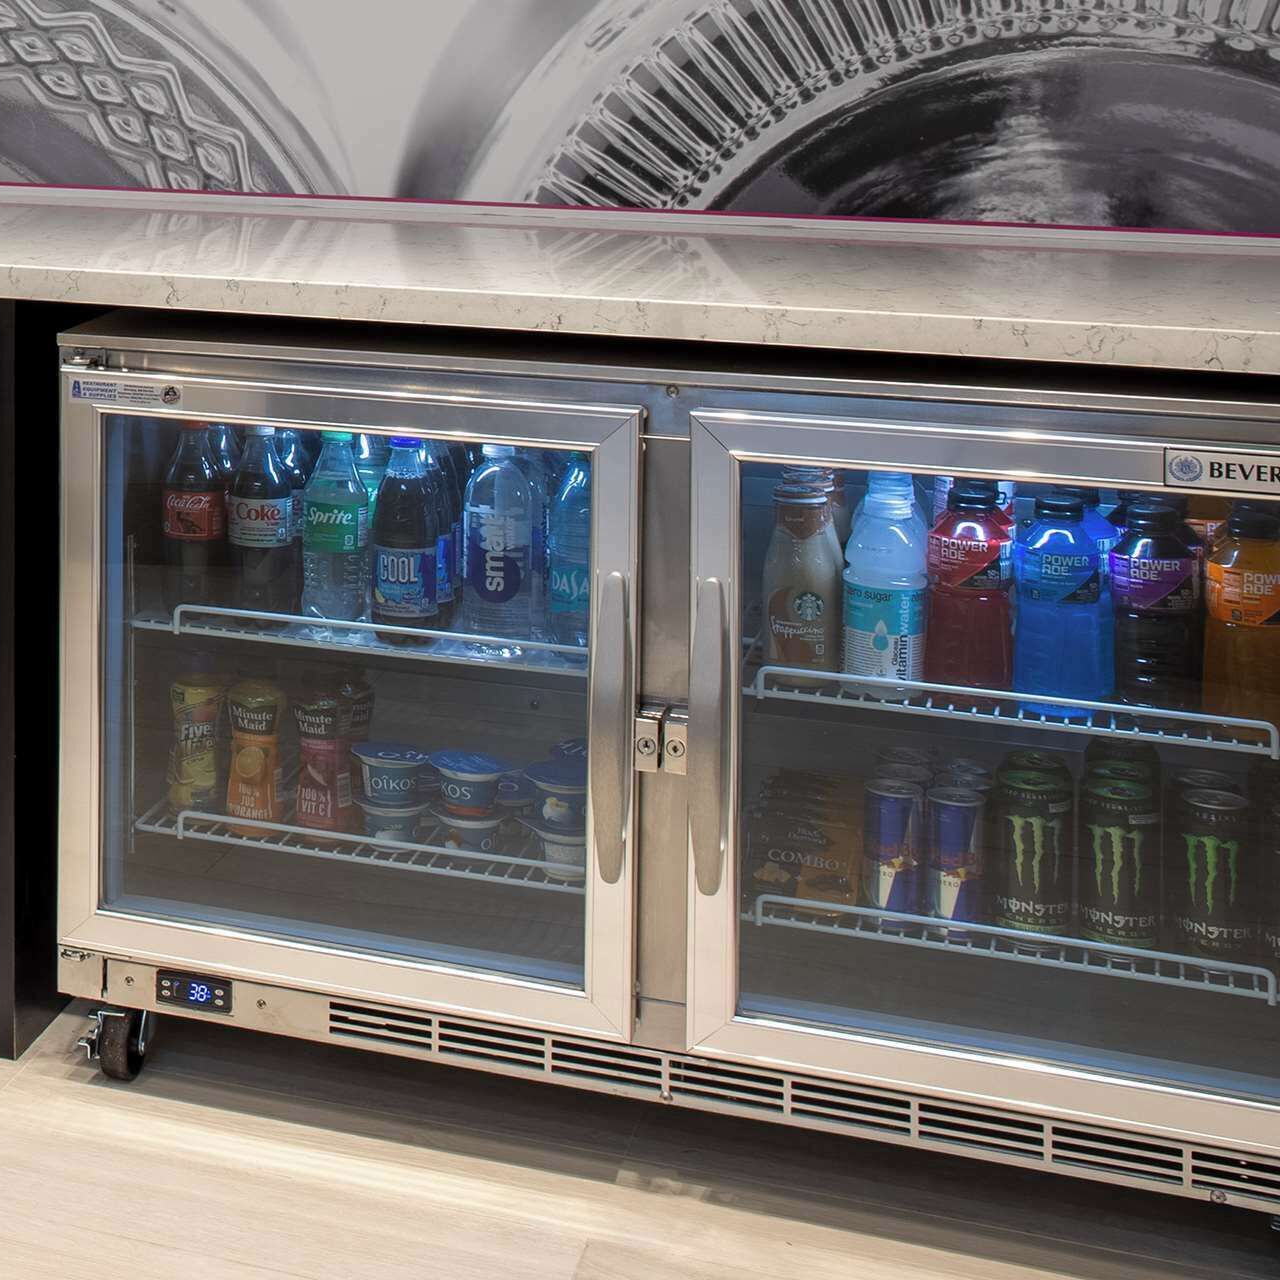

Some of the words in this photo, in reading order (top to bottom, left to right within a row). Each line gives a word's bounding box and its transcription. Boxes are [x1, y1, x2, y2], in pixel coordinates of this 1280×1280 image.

[1209, 461, 1280, 484] BEVER
[236, 502, 281, 521] Coke
[308, 506, 353, 525] Sprite
[941, 537, 989, 553] POWER
[941, 550, 967, 561] ADE
[1042, 553, 1090, 568] POWER
[380, 554, 419, 583] COOL
[1042, 565, 1072, 576] ADE
[1129, 557, 1180, 573] POWER
[1129, 569, 1161, 581] ADE
[864, 590, 893, 603] sugar
[1243, 583, 1274, 596] ADE
[232, 703, 273, 721] Minute
[181, 722, 211, 741] Five
[238, 719, 267, 732] Maid
[298, 721, 326, 736] Maid
[301, 798, 316, 814] VIT
